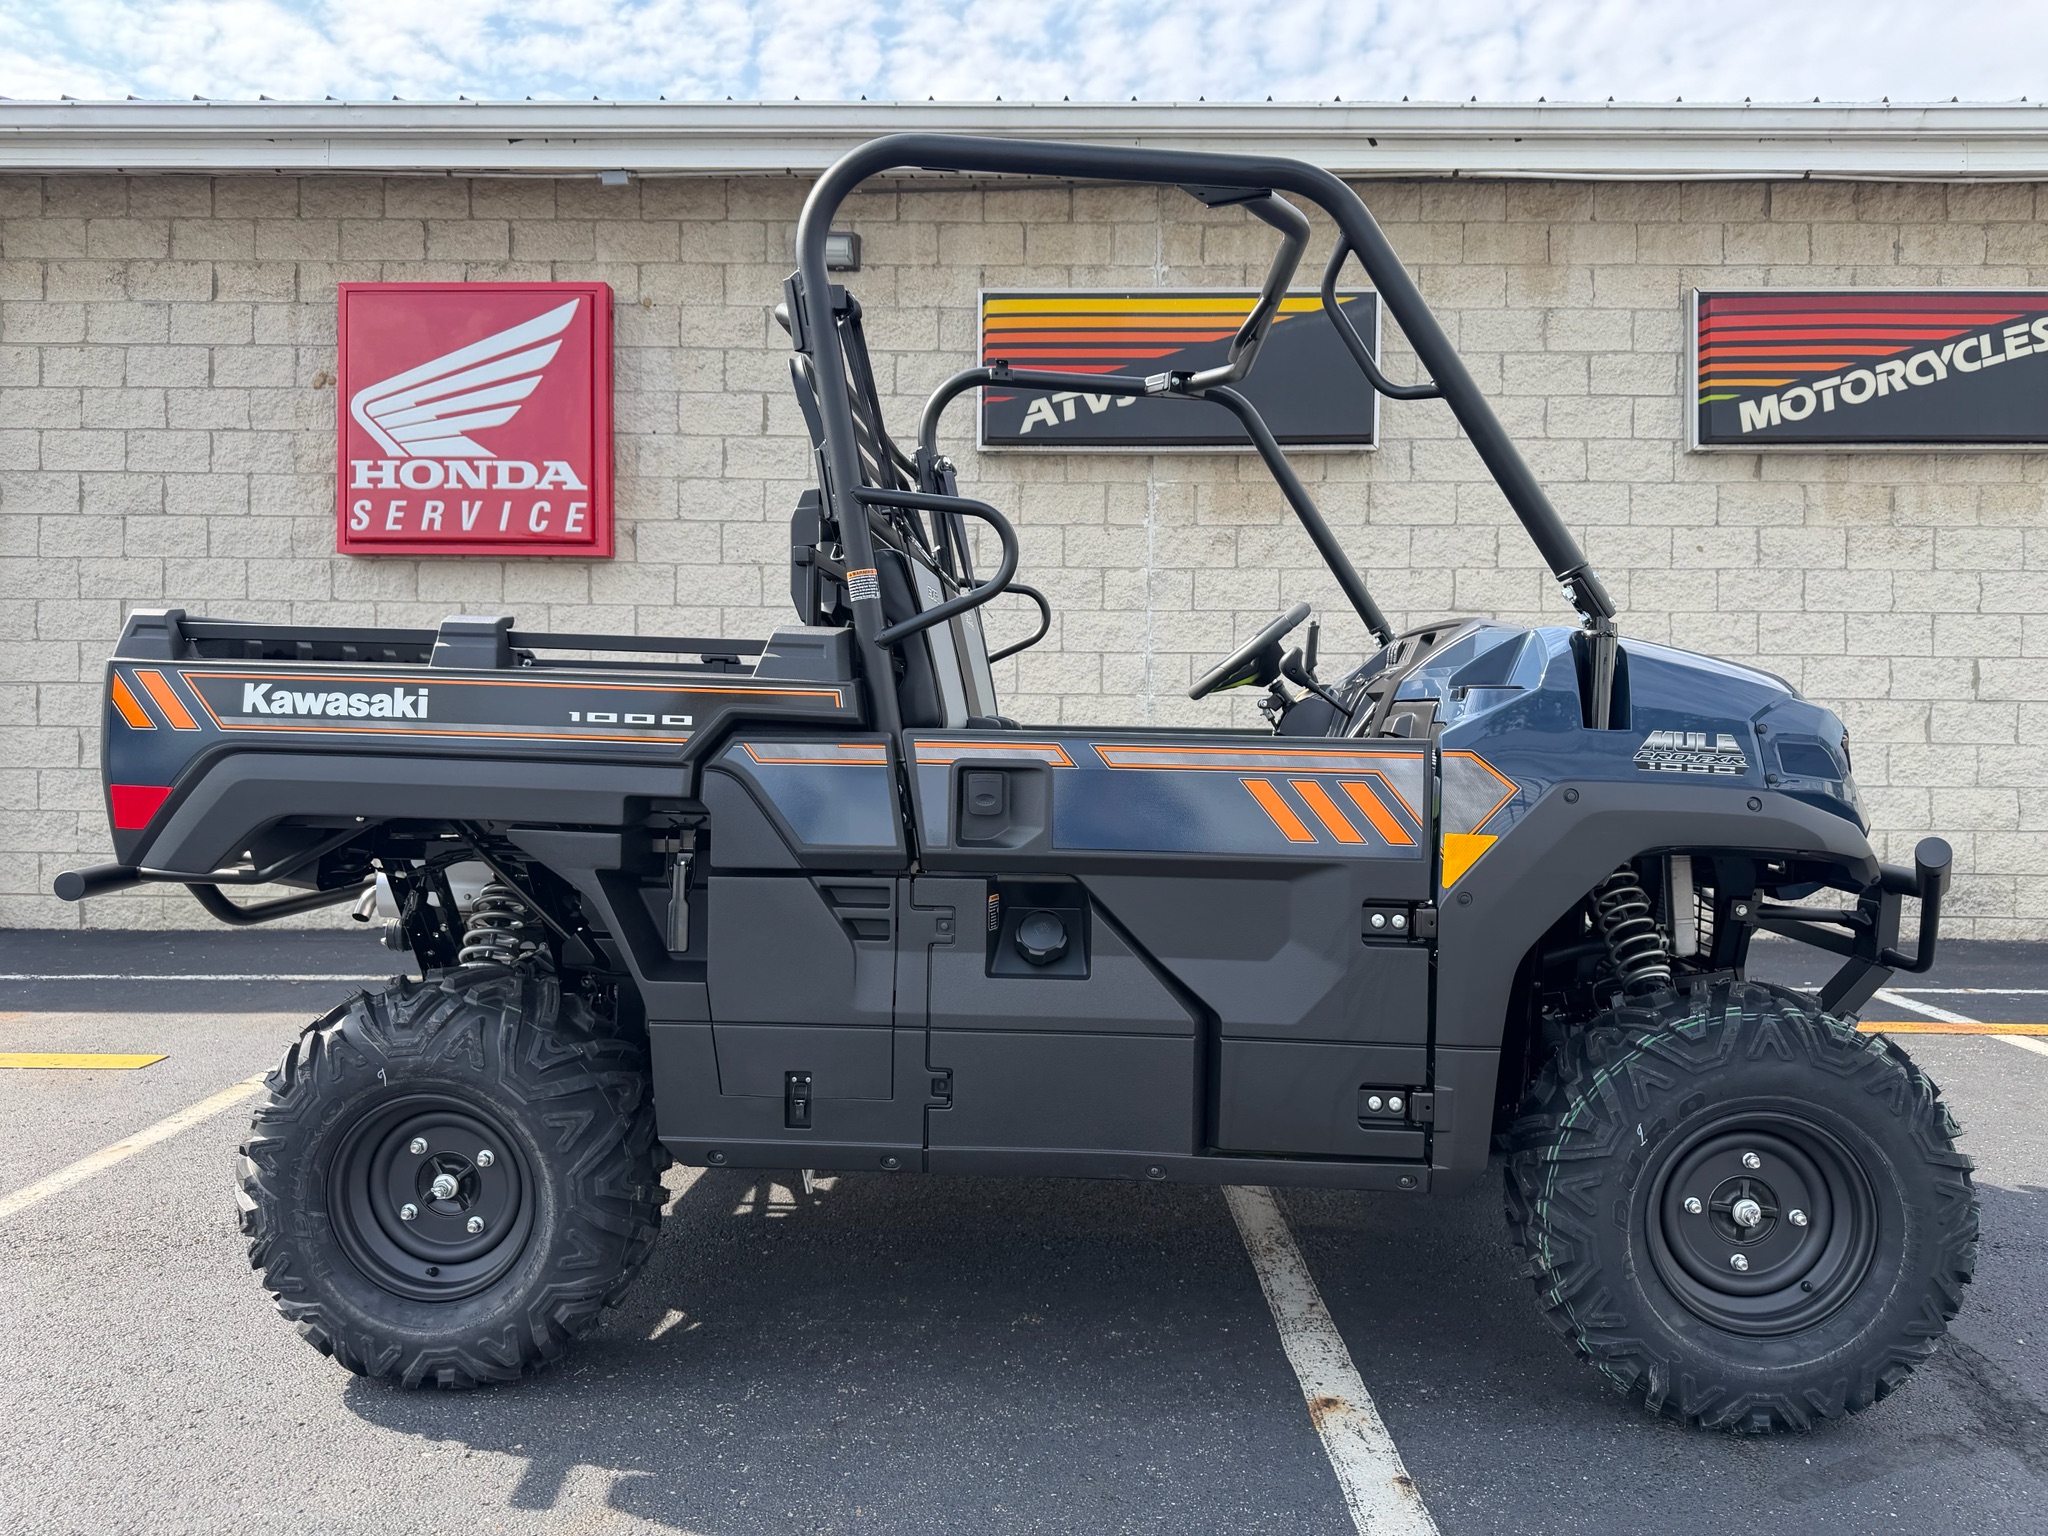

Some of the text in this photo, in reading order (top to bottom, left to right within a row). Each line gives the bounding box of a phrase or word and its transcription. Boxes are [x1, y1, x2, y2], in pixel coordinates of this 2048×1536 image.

[1739, 316, 2048, 433] MOTORCYCLES
[350, 459, 589, 490] HONDA
[350, 499, 588, 533] SERVICE
[242, 683, 429, 719] Kawasaki
[568, 711, 693, 726] 1000
[1639, 730, 1744, 755] MULE
[1632, 750, 1748, 767] PRO-FXR
[1647, 761, 1736, 774] 1000
